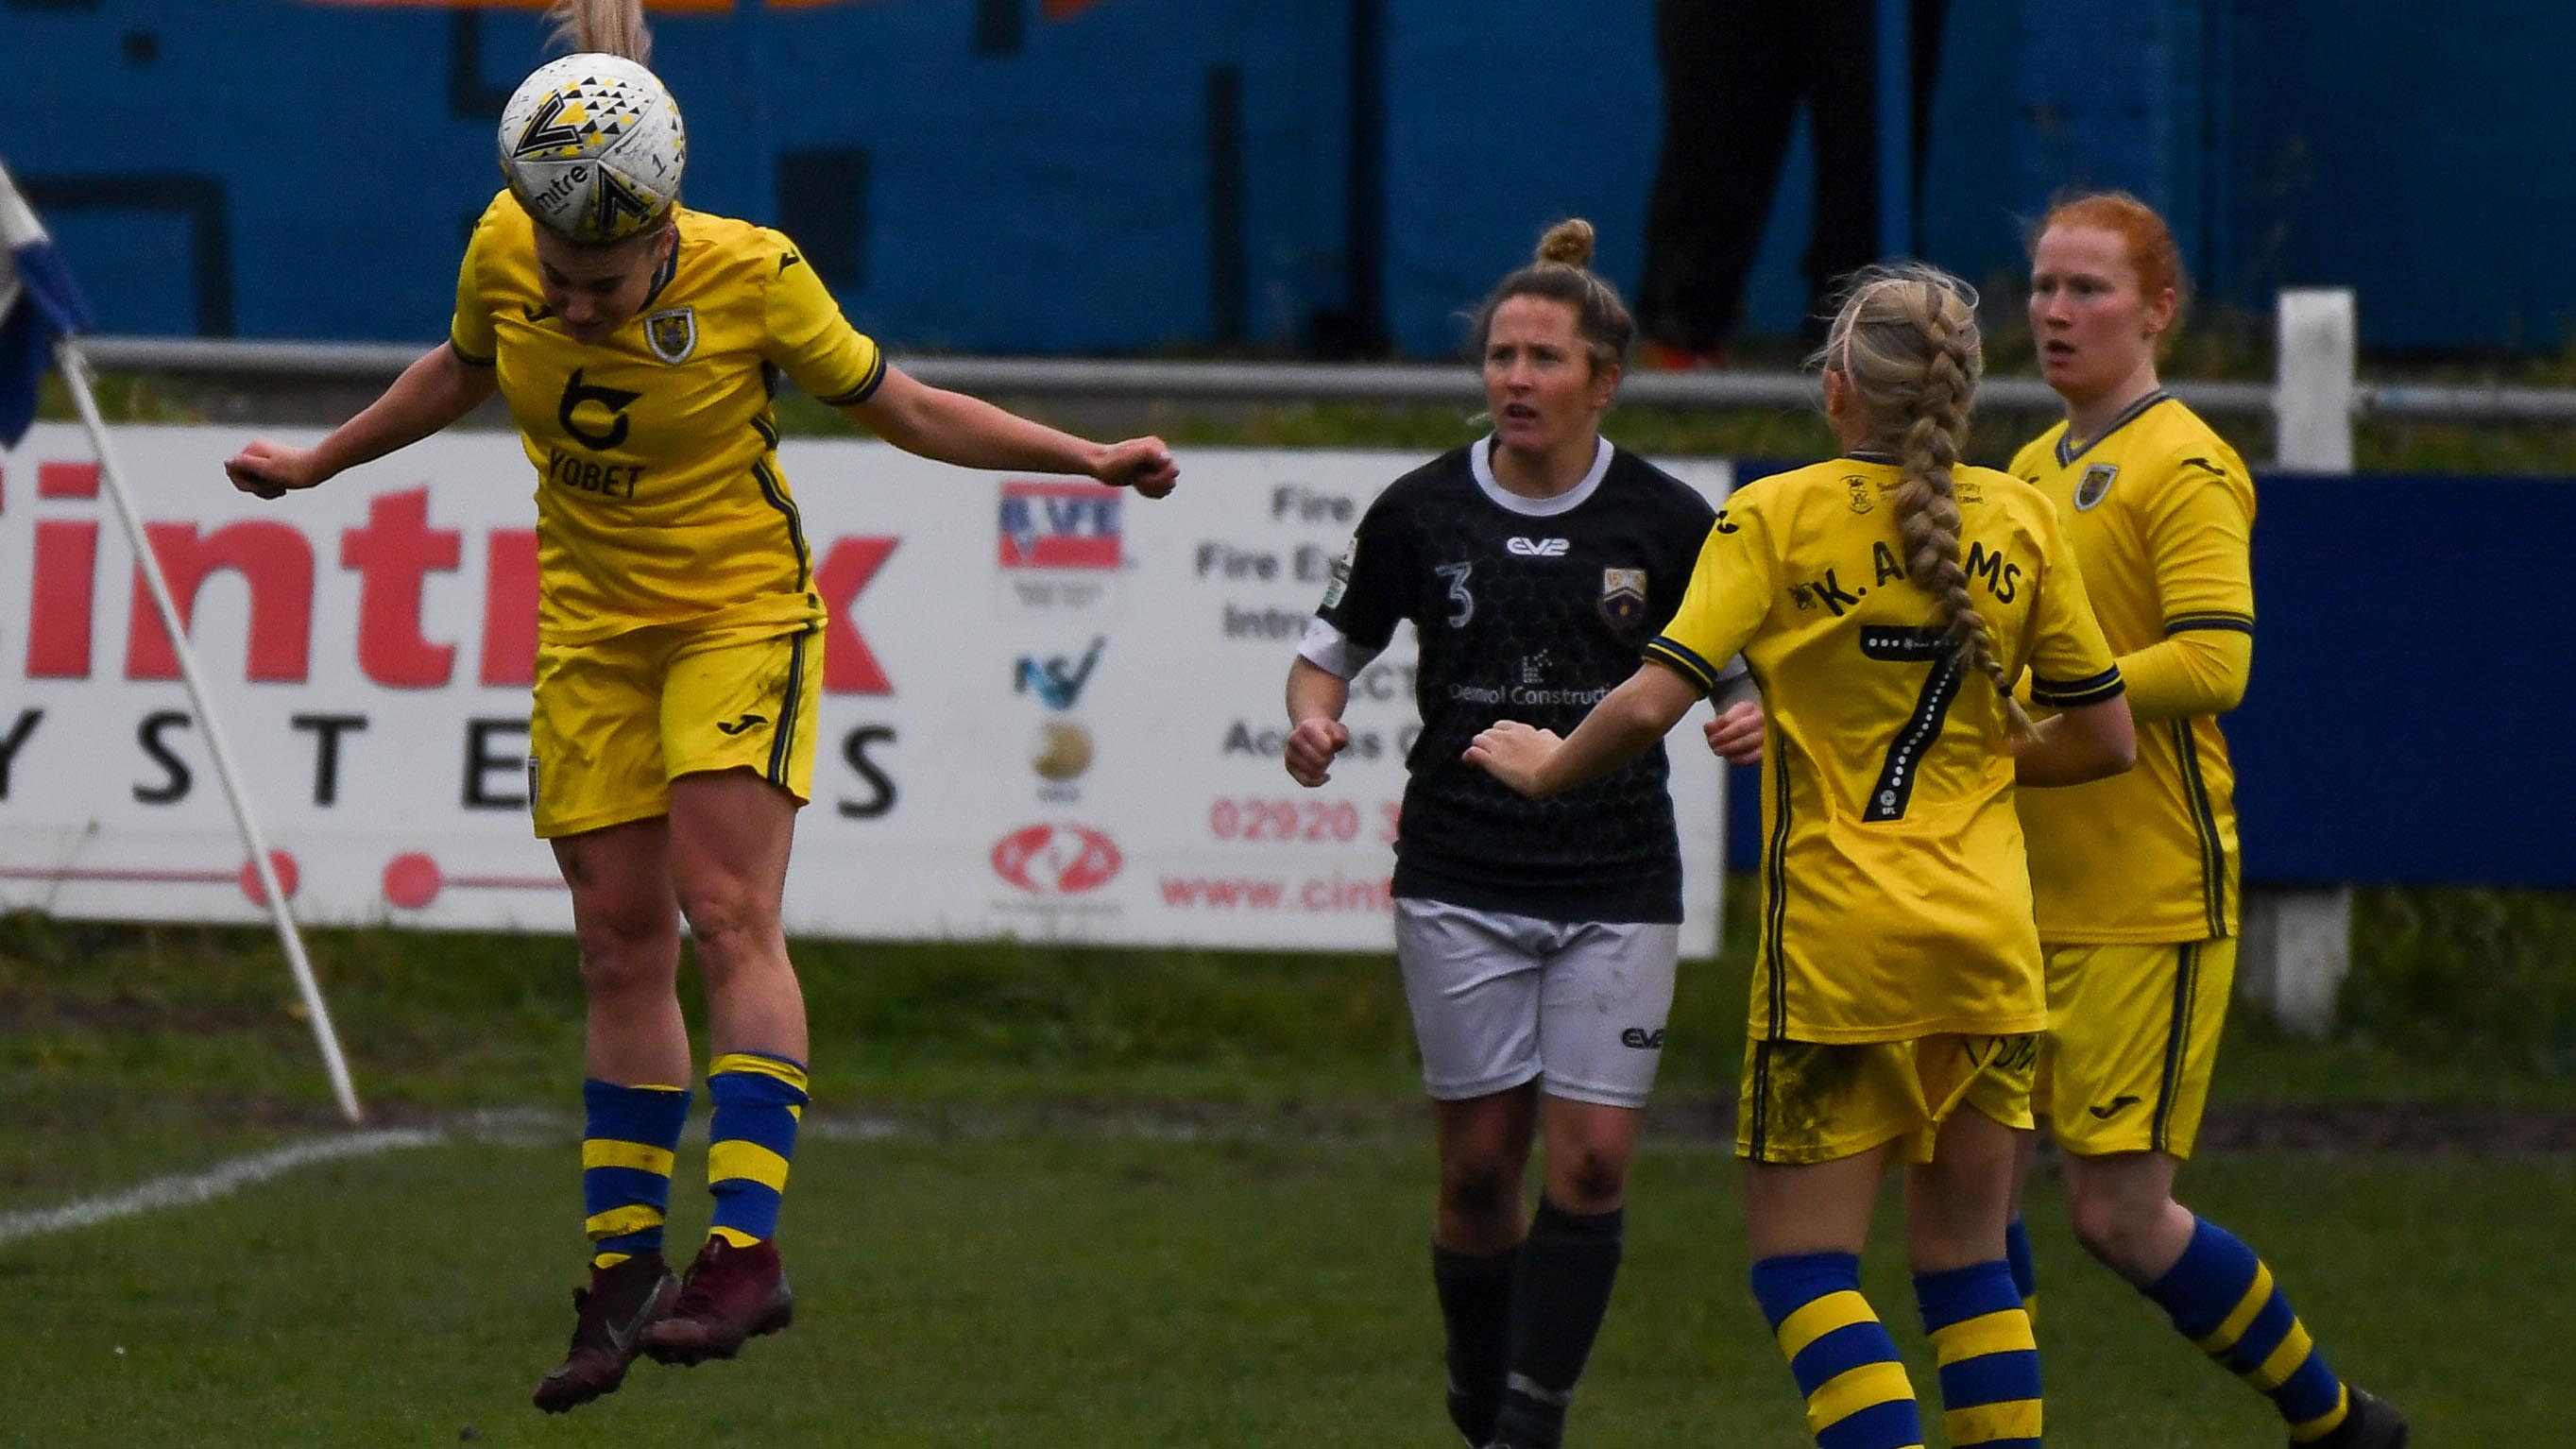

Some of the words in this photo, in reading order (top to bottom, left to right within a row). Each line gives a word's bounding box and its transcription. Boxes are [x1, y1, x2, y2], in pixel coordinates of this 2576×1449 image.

[535, 164, 589, 212] mitre
[652, 152, 668, 179] 1
[548, 445, 647, 500] YOBET
[1272, 485, 1354, 522] Fire
[1195, 539, 1278, 582] Fire
[1809, 568, 1868, 616] K.
[1872, 540, 2022, 605] AMS
[1435, 561, 1475, 628] 3
[1511, 683, 1613, 706] Construct
[1860, 625, 1969, 822] 7
[0, 708, 898, 820] YSTES
[1210, 796, 1359, 842] 02920
